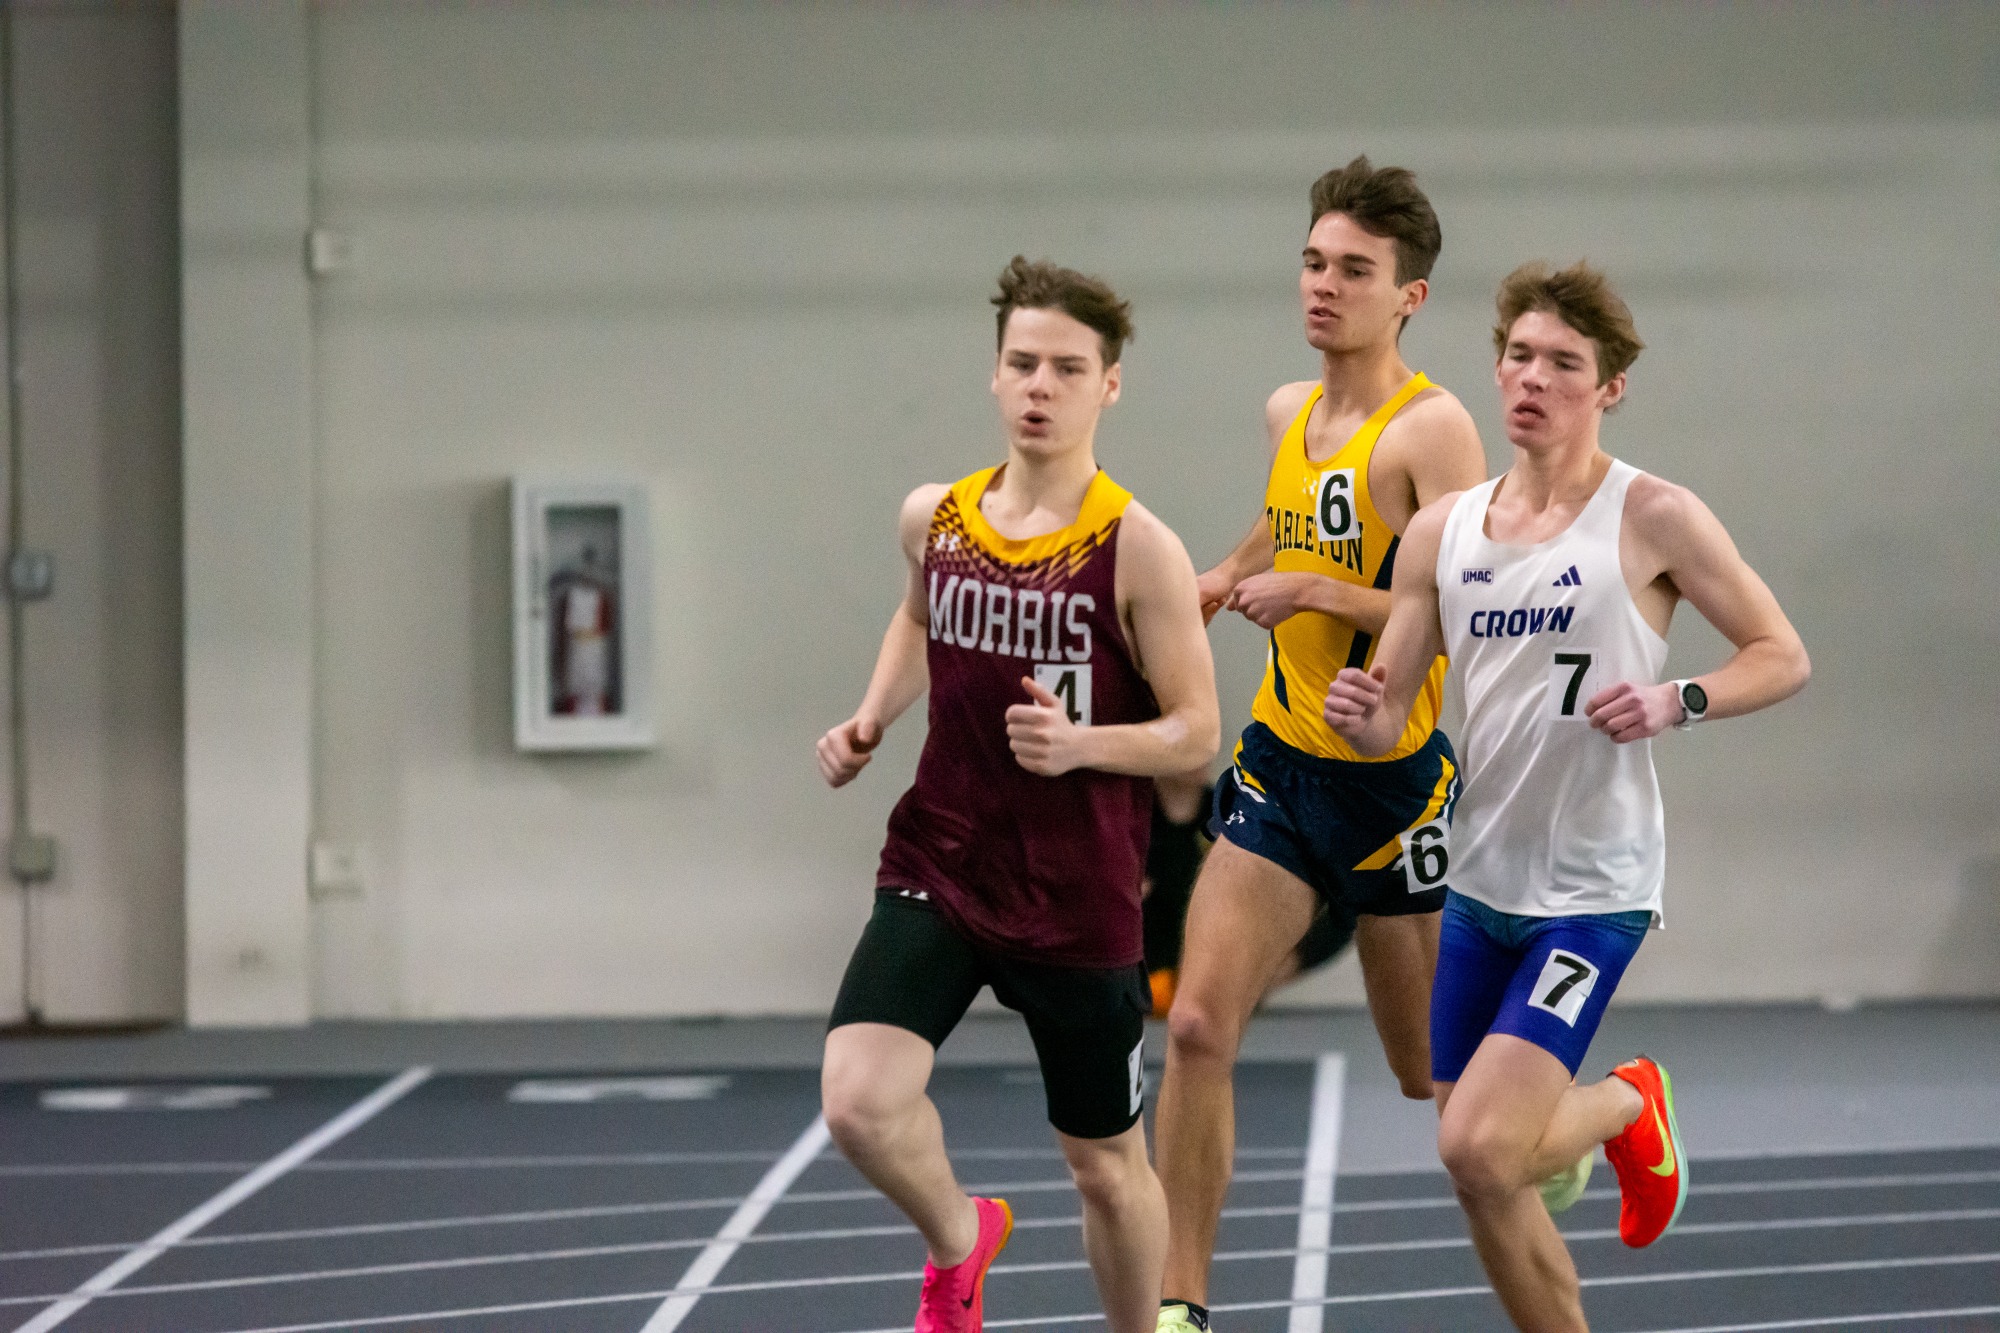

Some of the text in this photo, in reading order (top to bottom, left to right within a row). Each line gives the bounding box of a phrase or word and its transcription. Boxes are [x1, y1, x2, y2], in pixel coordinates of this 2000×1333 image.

[1321, 473, 1351, 536] 6
[1463, 570, 1492, 583] UMAC
[929, 571, 1096, 662] MORRIS
[1470, 606, 1575, 638] CROWN
[1554, 653, 1592, 716] 7
[1411, 825, 1449, 885] 6
[1542, 954, 1591, 1009] 7
